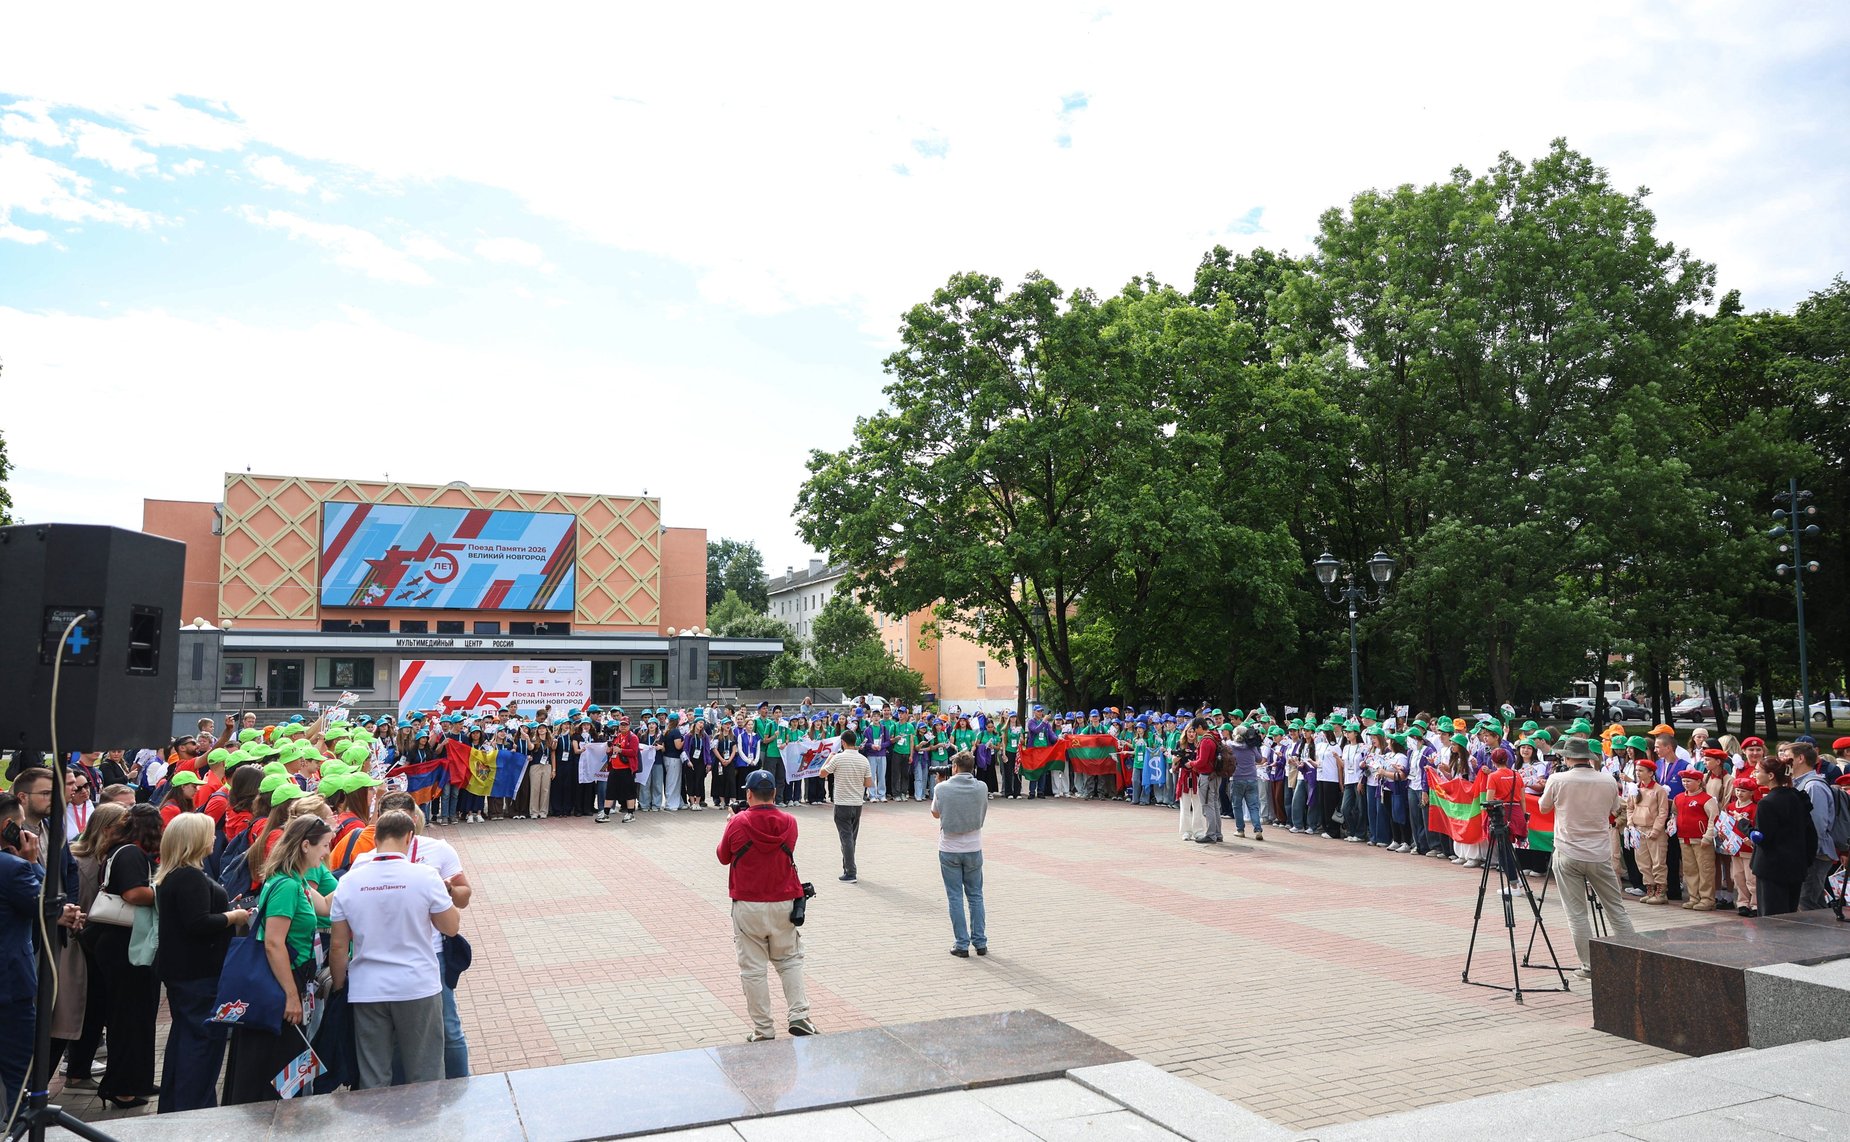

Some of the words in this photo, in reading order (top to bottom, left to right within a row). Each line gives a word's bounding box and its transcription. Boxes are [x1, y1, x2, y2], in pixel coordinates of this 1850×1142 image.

[468, 544, 494, 552] Поезд
[468, 552, 504, 560] ВЕЛИКИЙ
[433, 562, 452, 570] ЛЕТ
[396, 638, 454, 648] МУЛЬТИМЕДИЙНЫЙ
[464, 639, 483, 648] ЦЕНТР
[492, 640, 514, 648] РОССИЯ
